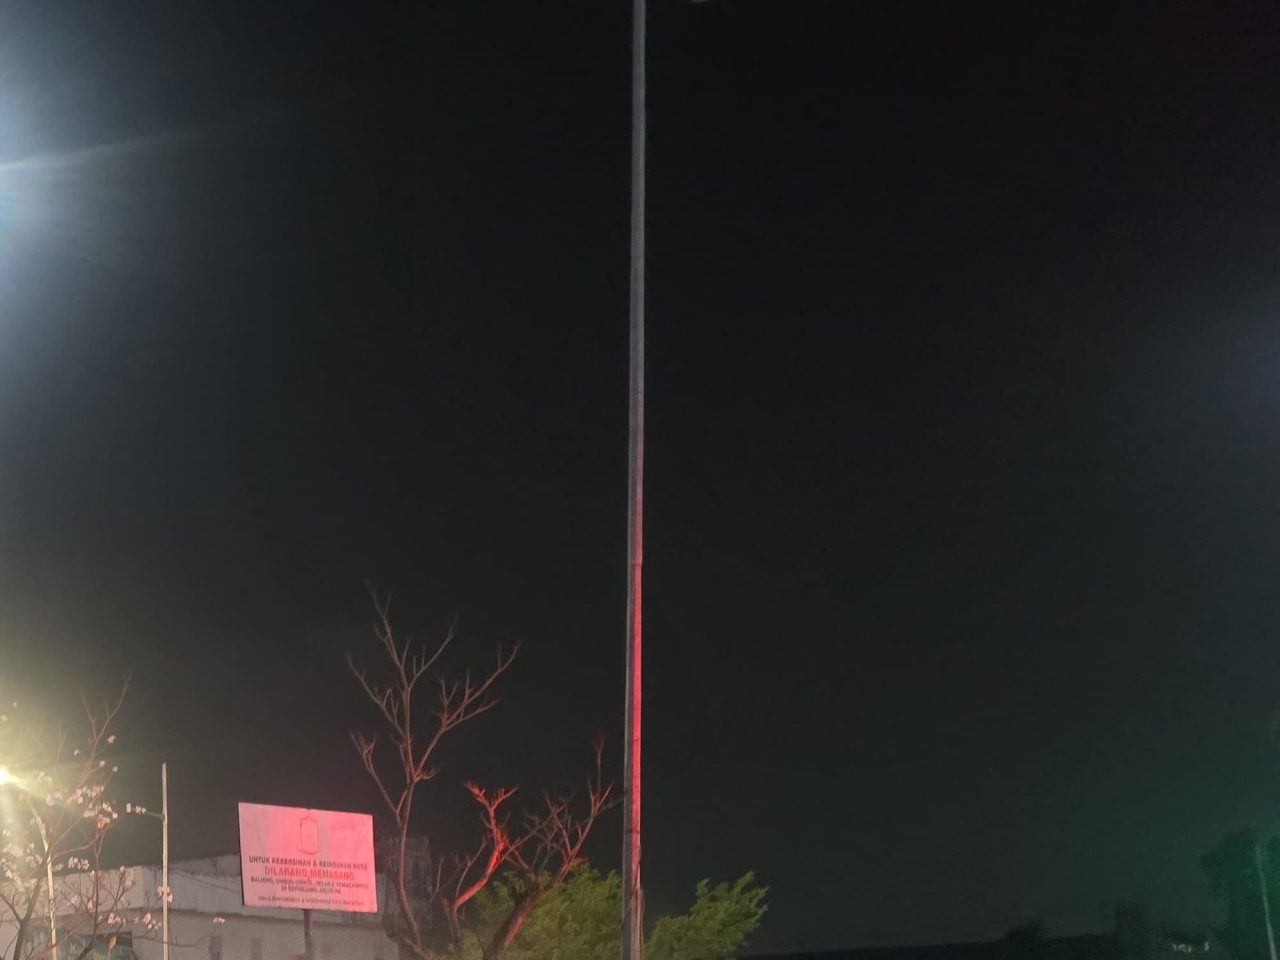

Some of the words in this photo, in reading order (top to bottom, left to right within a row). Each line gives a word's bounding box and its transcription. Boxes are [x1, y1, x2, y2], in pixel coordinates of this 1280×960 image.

[248, 856, 270, 865] UNTUK
[353, 863, 368, 871] KOTA
[264, 866, 307, 878] DILARANG
[308, 868, 355, 881] MEMASANG
